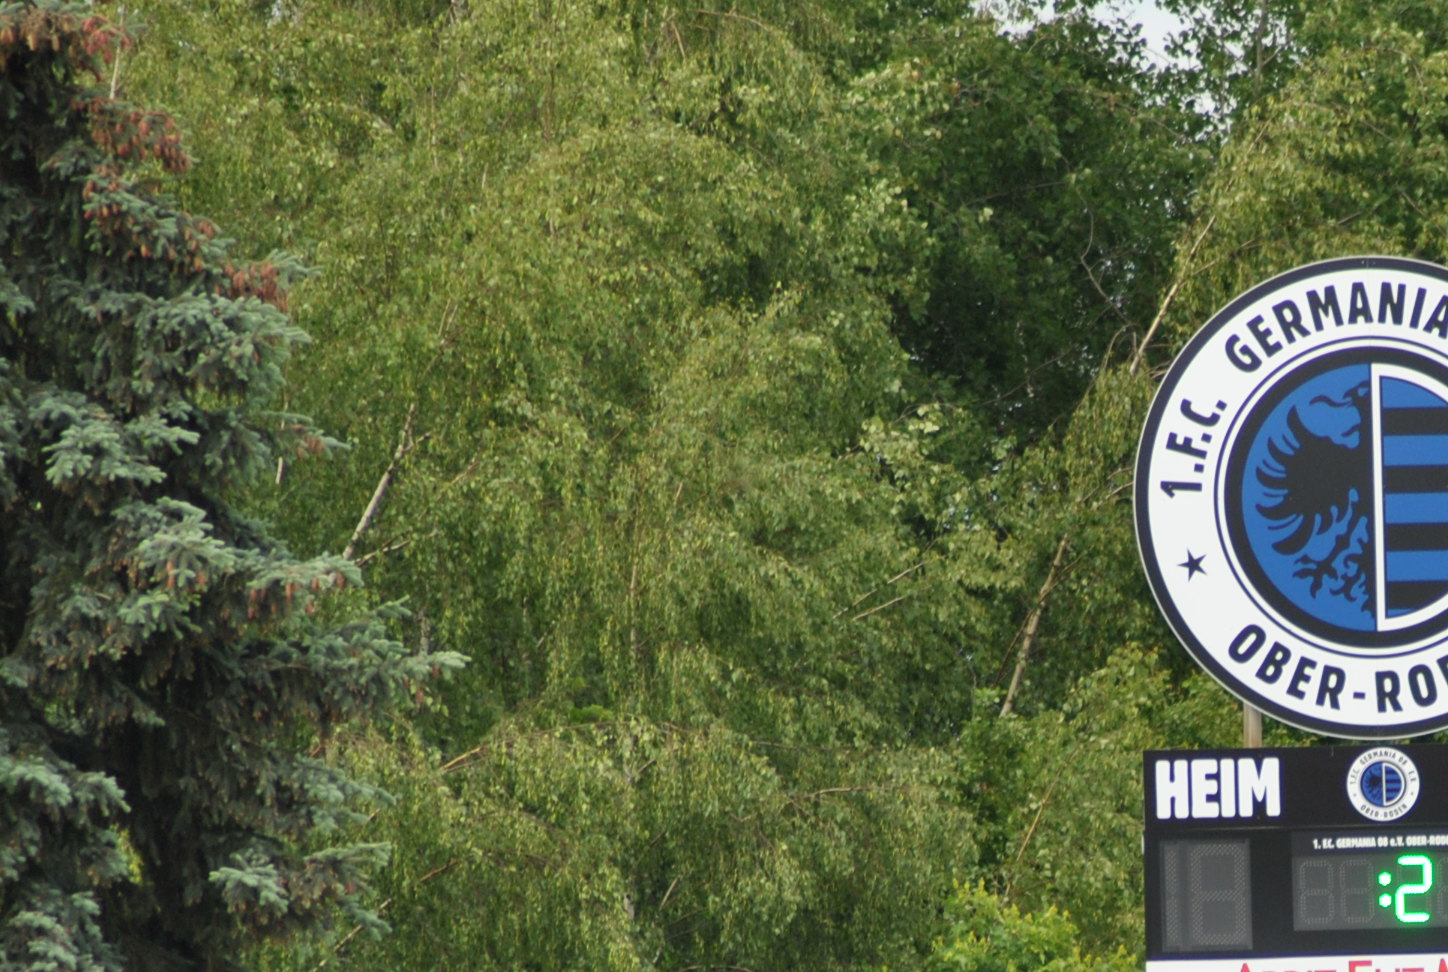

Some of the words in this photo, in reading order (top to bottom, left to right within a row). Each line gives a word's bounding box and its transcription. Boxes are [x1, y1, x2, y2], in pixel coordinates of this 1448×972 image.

[1160, 397, 1228, 499] 1.F.C.
[1359, 750, 1396, 765] GERMANIA
[1155, 757, 1281, 819] HEIM
[1360, 804, 1407, 818] OBER-RODEN
[1336, 837, 1376, 849] GERMANIA
[1377, 836, 1388, 847] 08
[1390, 836, 1404, 847] e.V.
